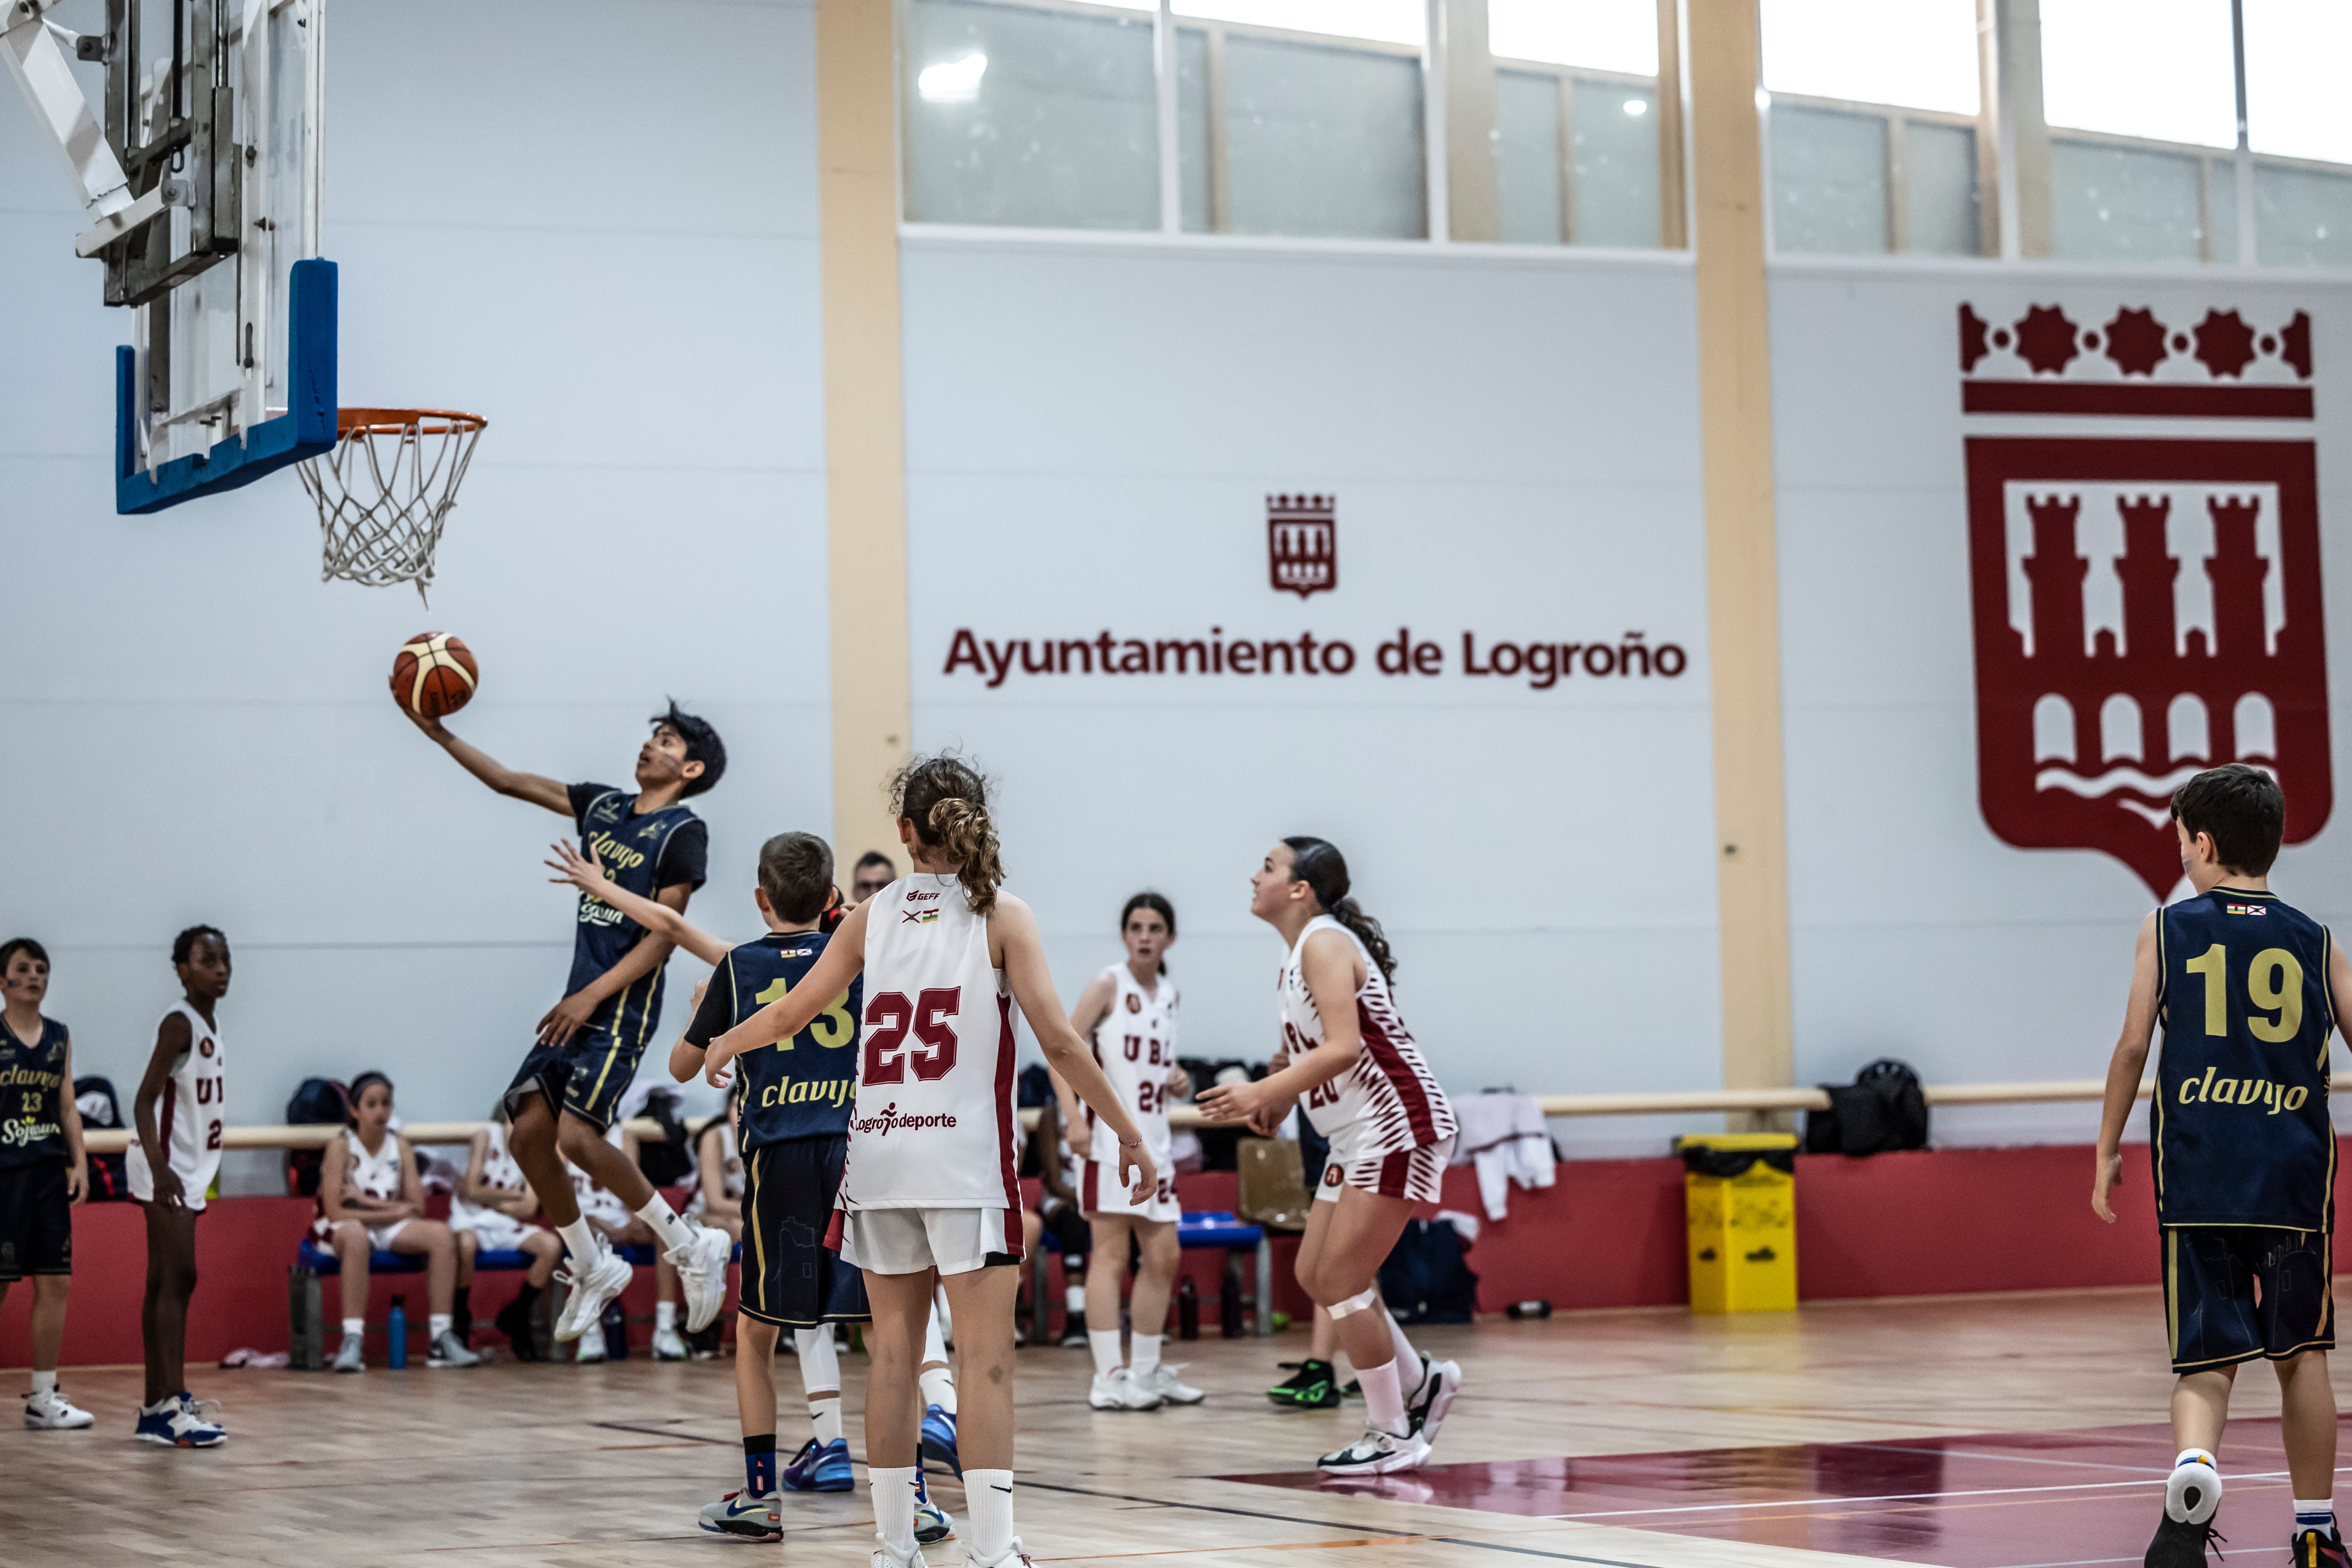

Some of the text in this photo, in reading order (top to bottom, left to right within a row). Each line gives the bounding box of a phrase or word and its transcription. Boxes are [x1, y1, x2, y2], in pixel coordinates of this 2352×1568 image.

[944, 628, 1687, 689] Ayuntamiento de Logroño
[756, 978, 854, 1051] 13
[2186, 944, 2303, 1042] 19
[862, 986, 961, 1086] 25
[22, 1091, 42, 1112] 23
[2179, 1067, 2308, 1115] clavijo
